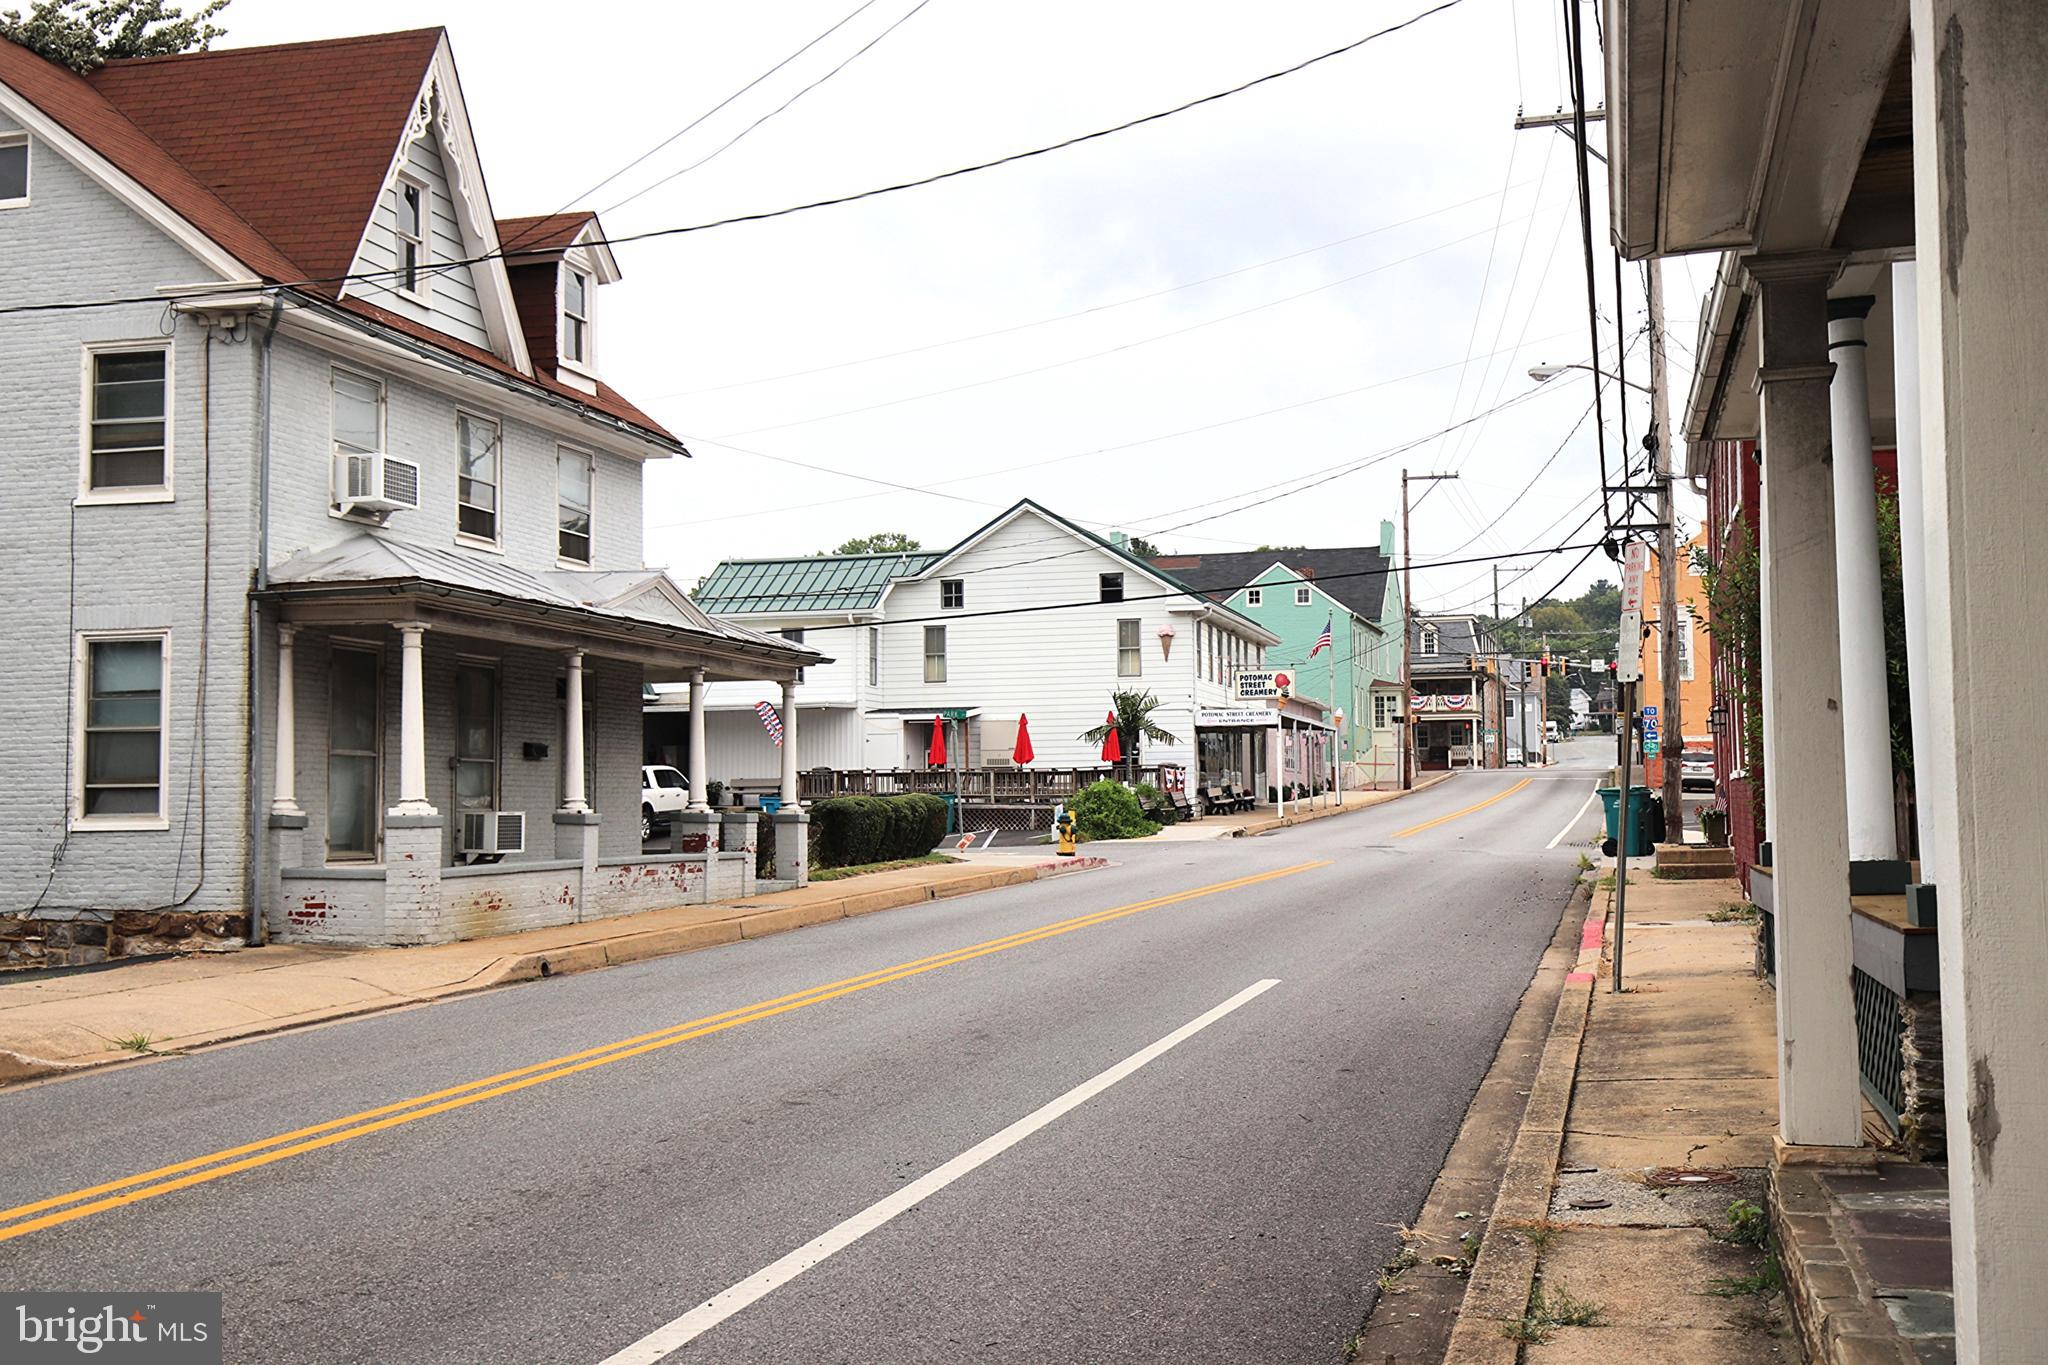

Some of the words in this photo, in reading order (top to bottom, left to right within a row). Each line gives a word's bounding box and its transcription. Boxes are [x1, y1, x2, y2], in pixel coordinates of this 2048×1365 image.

[1631, 547, 1639, 558] NO
[1626, 561, 1644, 571] PARKING
[943, 710, 958, 718] PARK
[1644, 719, 1657, 728] 70
